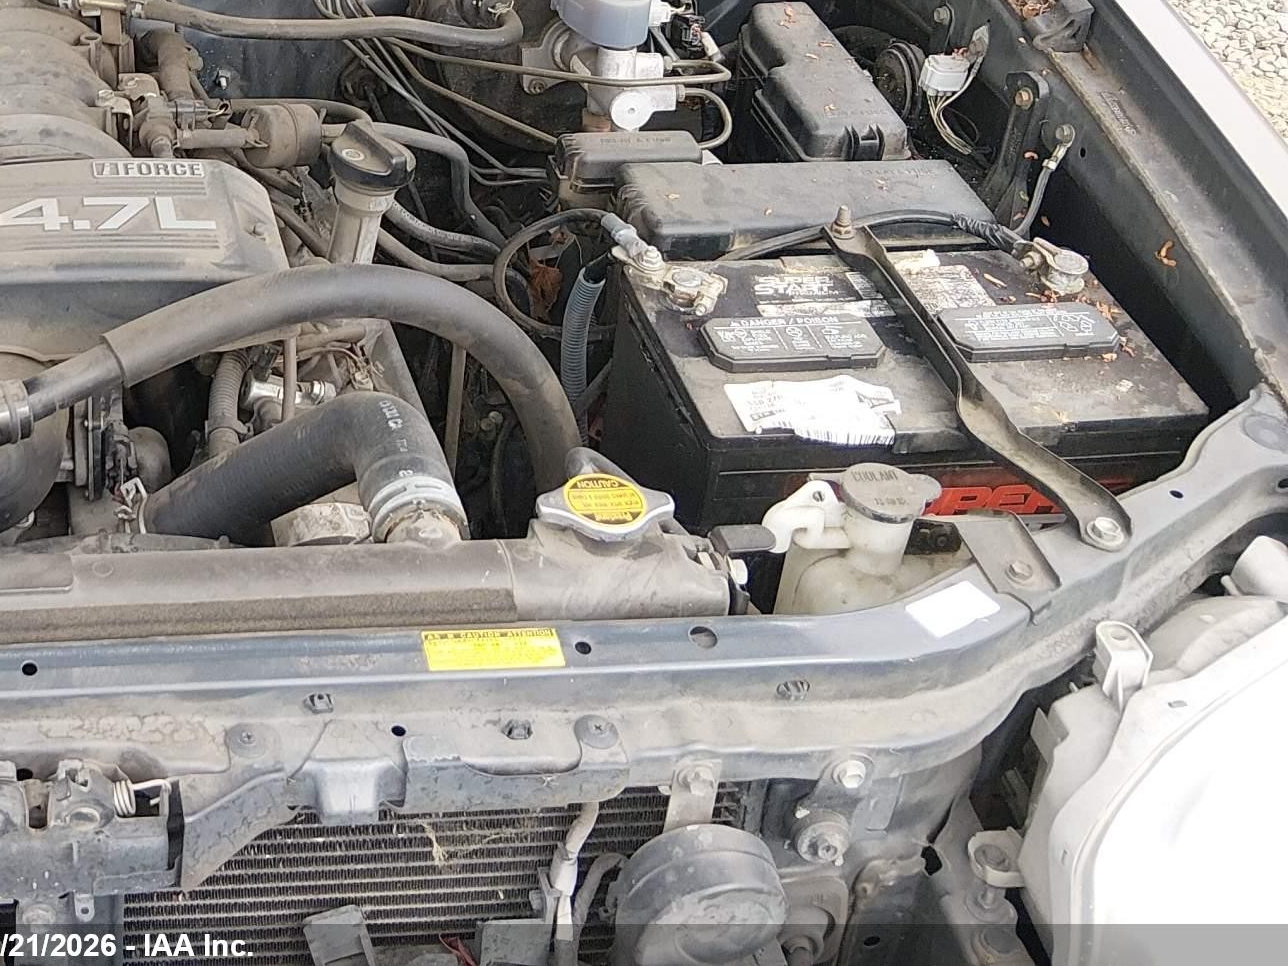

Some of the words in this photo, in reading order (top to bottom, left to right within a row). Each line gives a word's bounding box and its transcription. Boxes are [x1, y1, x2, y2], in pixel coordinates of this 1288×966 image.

[754, 283, 834, 295] START
[740, 318, 787, 327] DANGER
[795, 316, 839, 325] POISON
[850, 469, 899, 483] COOLANT
[576, 479, 620, 489] CAUTION
